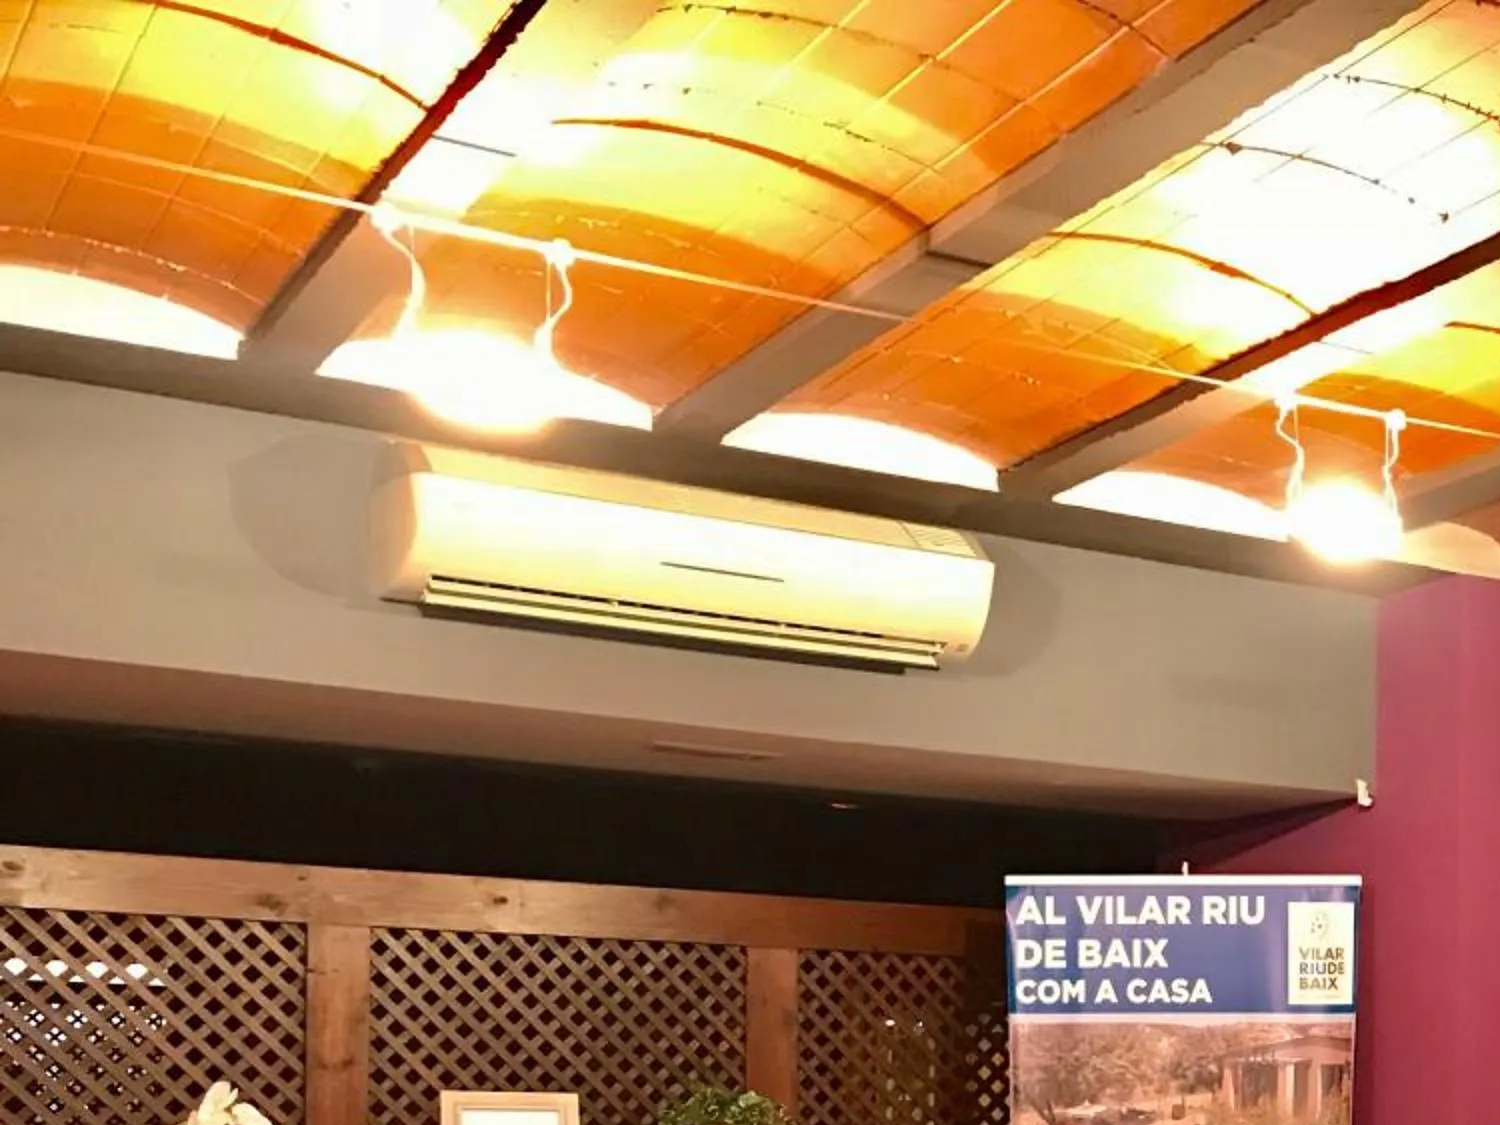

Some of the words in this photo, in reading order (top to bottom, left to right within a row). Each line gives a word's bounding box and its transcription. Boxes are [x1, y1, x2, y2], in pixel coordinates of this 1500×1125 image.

[1015, 894, 1067, 925] AL
[1076, 894, 1192, 925] VILAR
[1202, 894, 1265, 925] RIU
[1016, 938, 1067, 969] DE
[1077, 938, 1169, 969] BAIX
[1299, 946, 1345, 960] VILAR
[1015, 979, 1087, 1004] COM
[1094, 979, 1119, 1004] A
[1126, 979, 1213, 1004] CASA
[1299, 977, 1339, 990] BAIX
